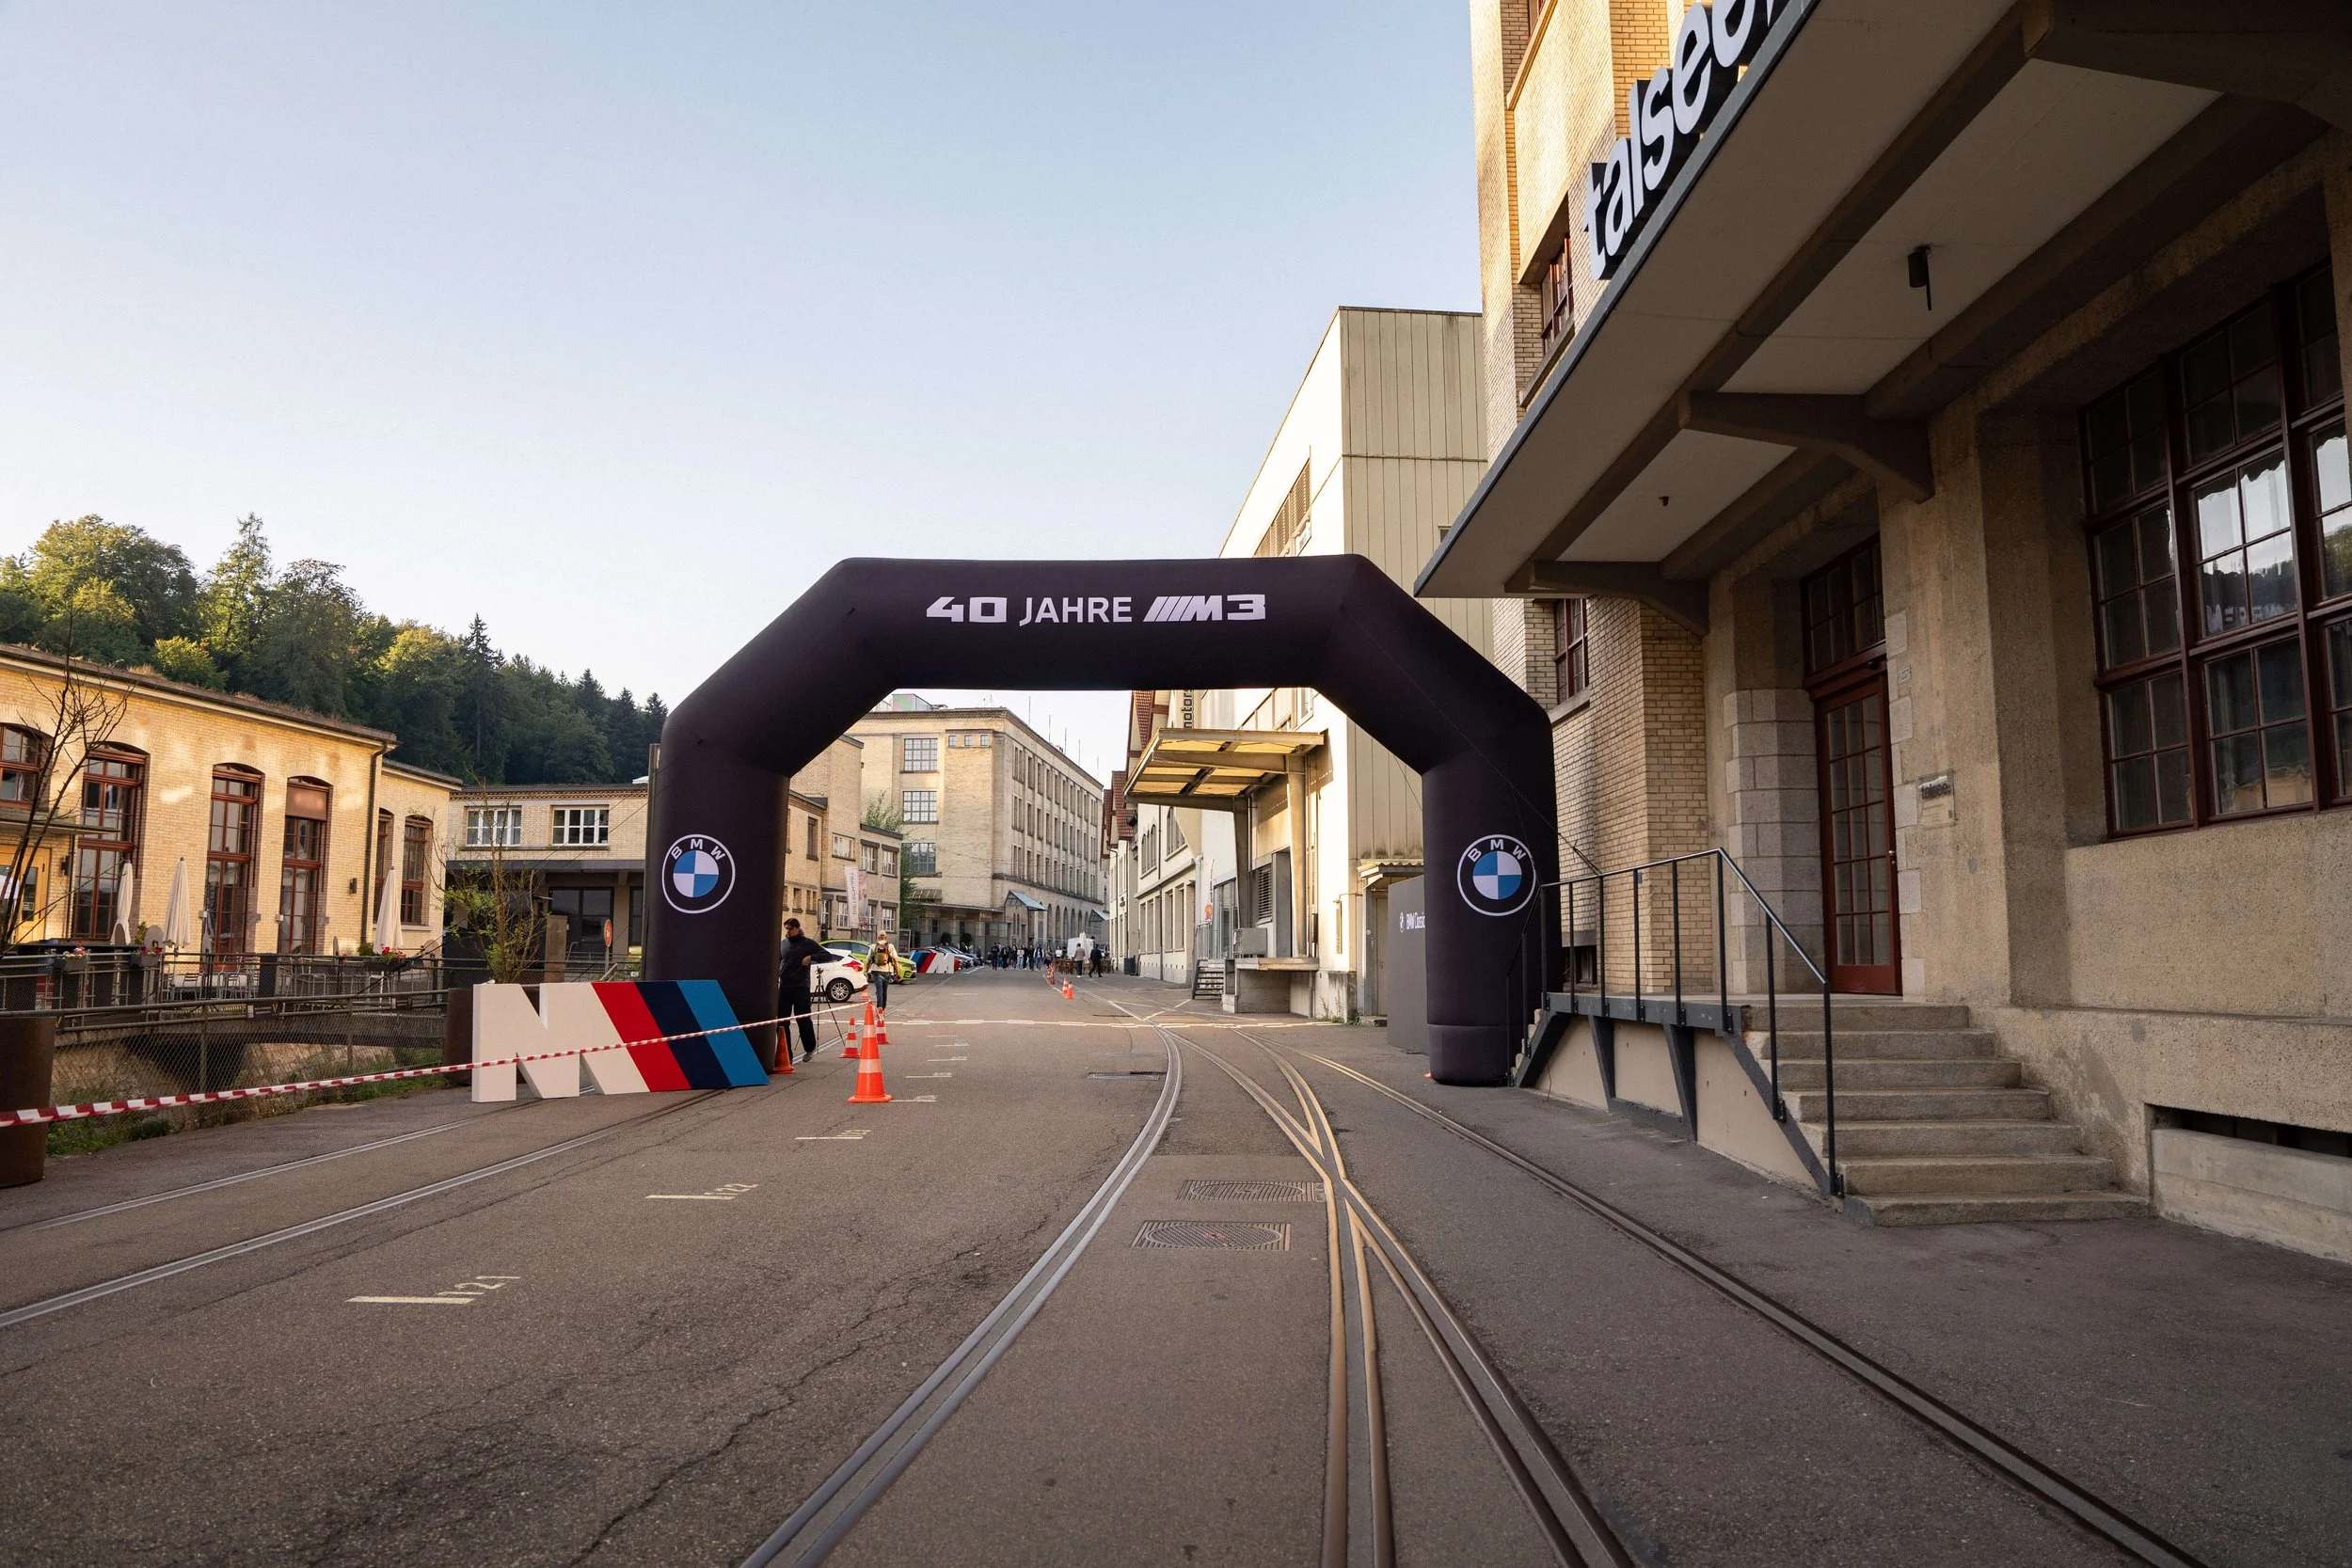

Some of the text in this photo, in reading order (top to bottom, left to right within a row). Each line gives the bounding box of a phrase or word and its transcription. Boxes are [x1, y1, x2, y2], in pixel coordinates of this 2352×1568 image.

[926, 595, 1008, 623] 40
[1019, 595, 1133, 626] JAHRE
[671, 838, 725, 861] BMW
[1468, 839, 1527, 862] BMW
